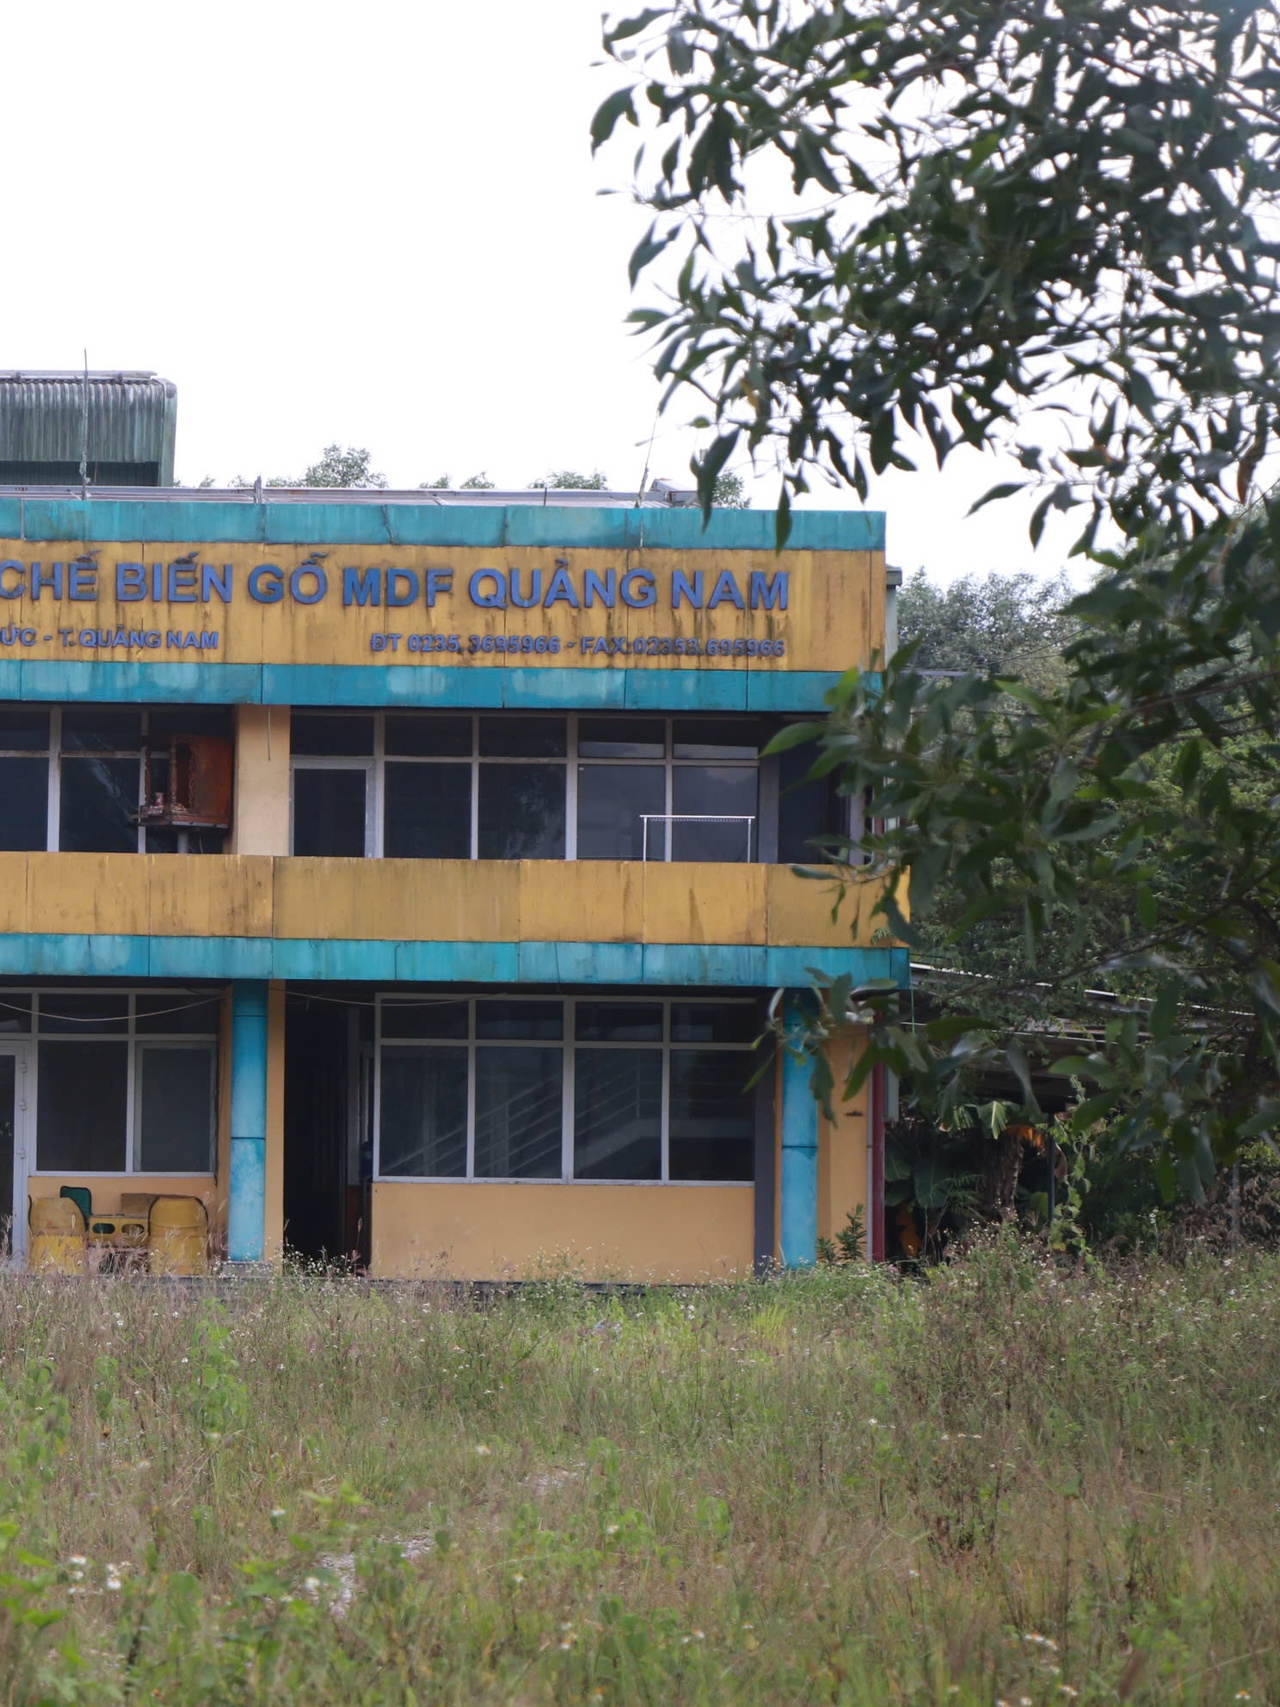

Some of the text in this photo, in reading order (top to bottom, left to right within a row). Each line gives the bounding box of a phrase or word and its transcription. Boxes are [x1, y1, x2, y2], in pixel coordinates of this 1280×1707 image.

[116, 551, 234, 603] BIẾN
[248, 552, 328, 605] GỖ
[342, 566, 454, 608] MDF
[468, 558, 658, 610] QUẢNG
[671, 569, 790, 611] NAM
[167, 631, 219, 650] NAM
